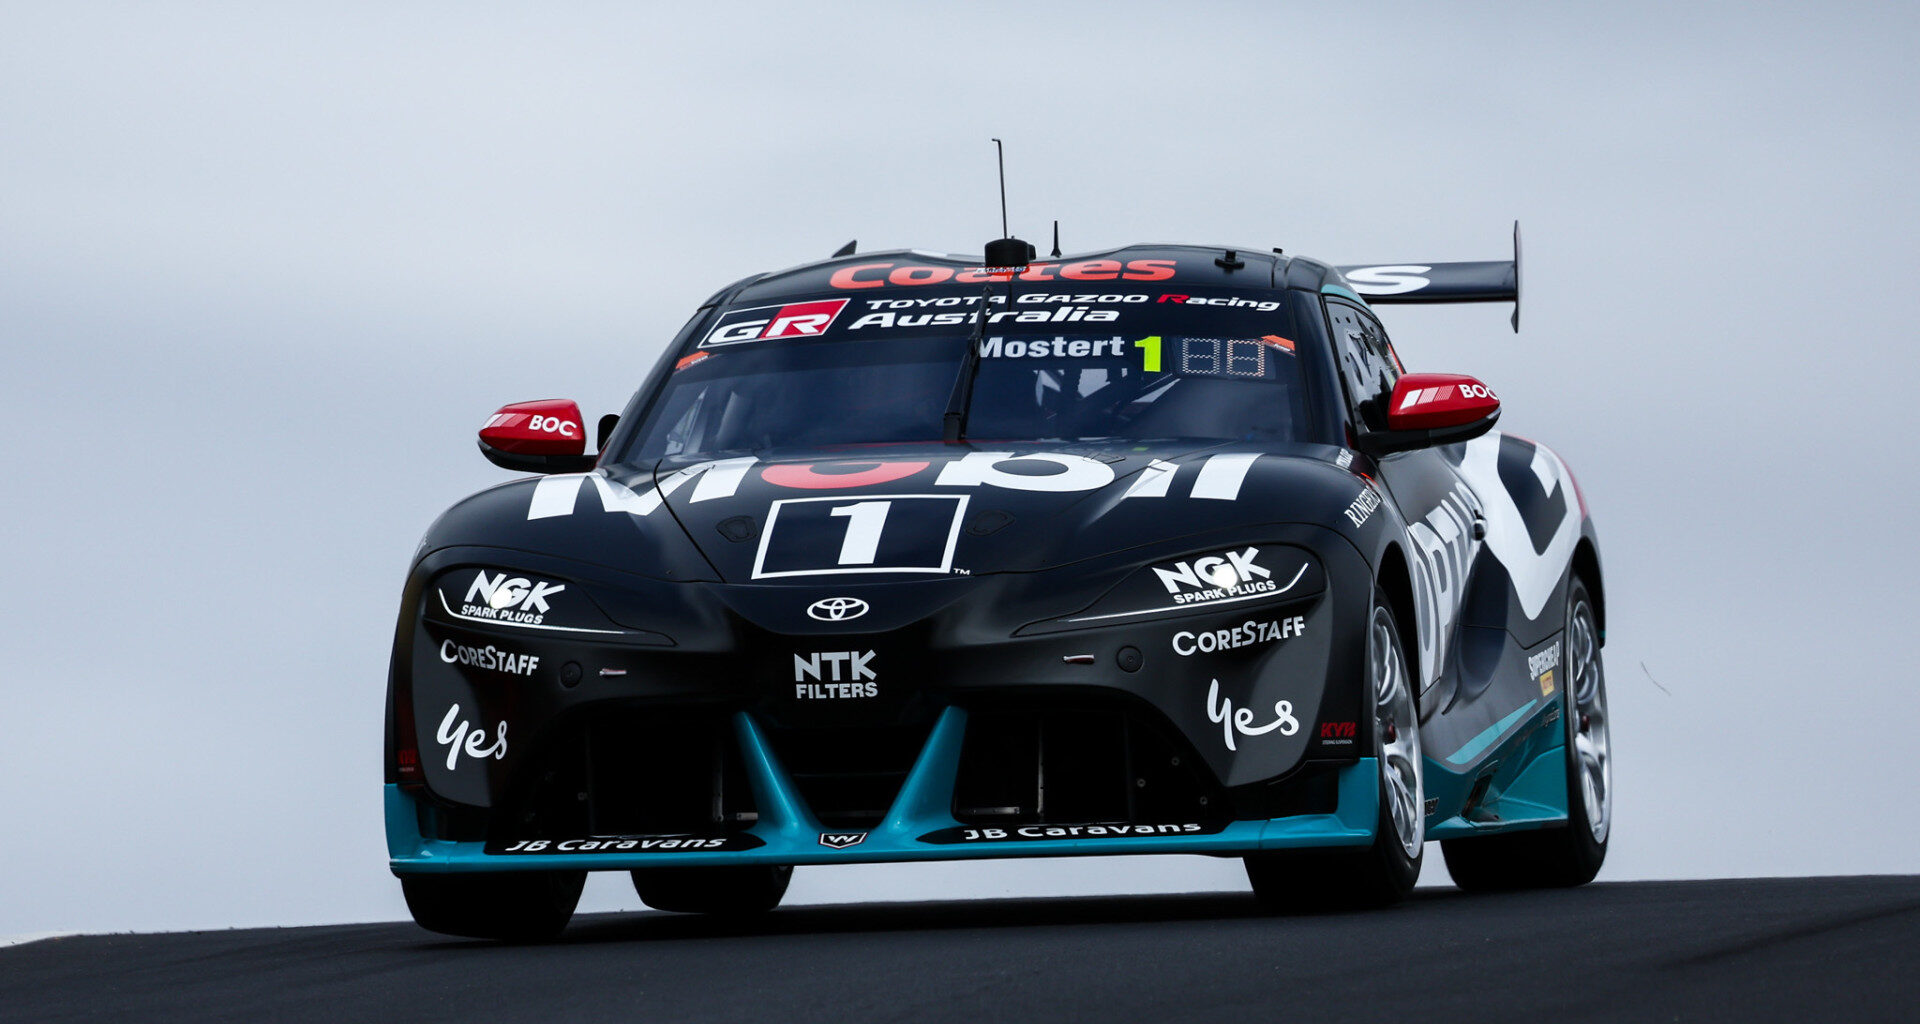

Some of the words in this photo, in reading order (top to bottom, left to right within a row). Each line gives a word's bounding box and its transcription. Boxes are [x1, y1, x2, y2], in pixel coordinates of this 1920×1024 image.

[830, 260, 1177, 289] Coates
[866, 295, 1007, 310] TOYOTA
[1017, 293, 1149, 303] GAZOO
[1157, 293, 1281, 312] Racing
[708, 313, 831, 344] GR
[848, 306, 1120, 330] Australia
[979, 336, 1125, 358] Mostert
[1134, 336, 1161, 372] 1
[528, 414, 577, 436] BOC
[527, 452, 1264, 520] Mobil
[830, 501, 892, 565] 1
[1152, 546, 1271, 594] NGK
[464, 569, 565, 614] NGK
[1173, 587, 1226, 604] SPARK
[1229, 580, 1277, 597] PLUGS
[461, 604, 498, 619] SPARK
[500, 610, 544, 625] PLUGS
[794, 649, 877, 682] NTK
[796, 682, 878, 699] FILTERS
[964, 828, 1008, 840] JB
[1016, 820, 1202, 837] Caravans
[505, 840, 551, 851] JB
[557, 838, 727, 851] Caravans
